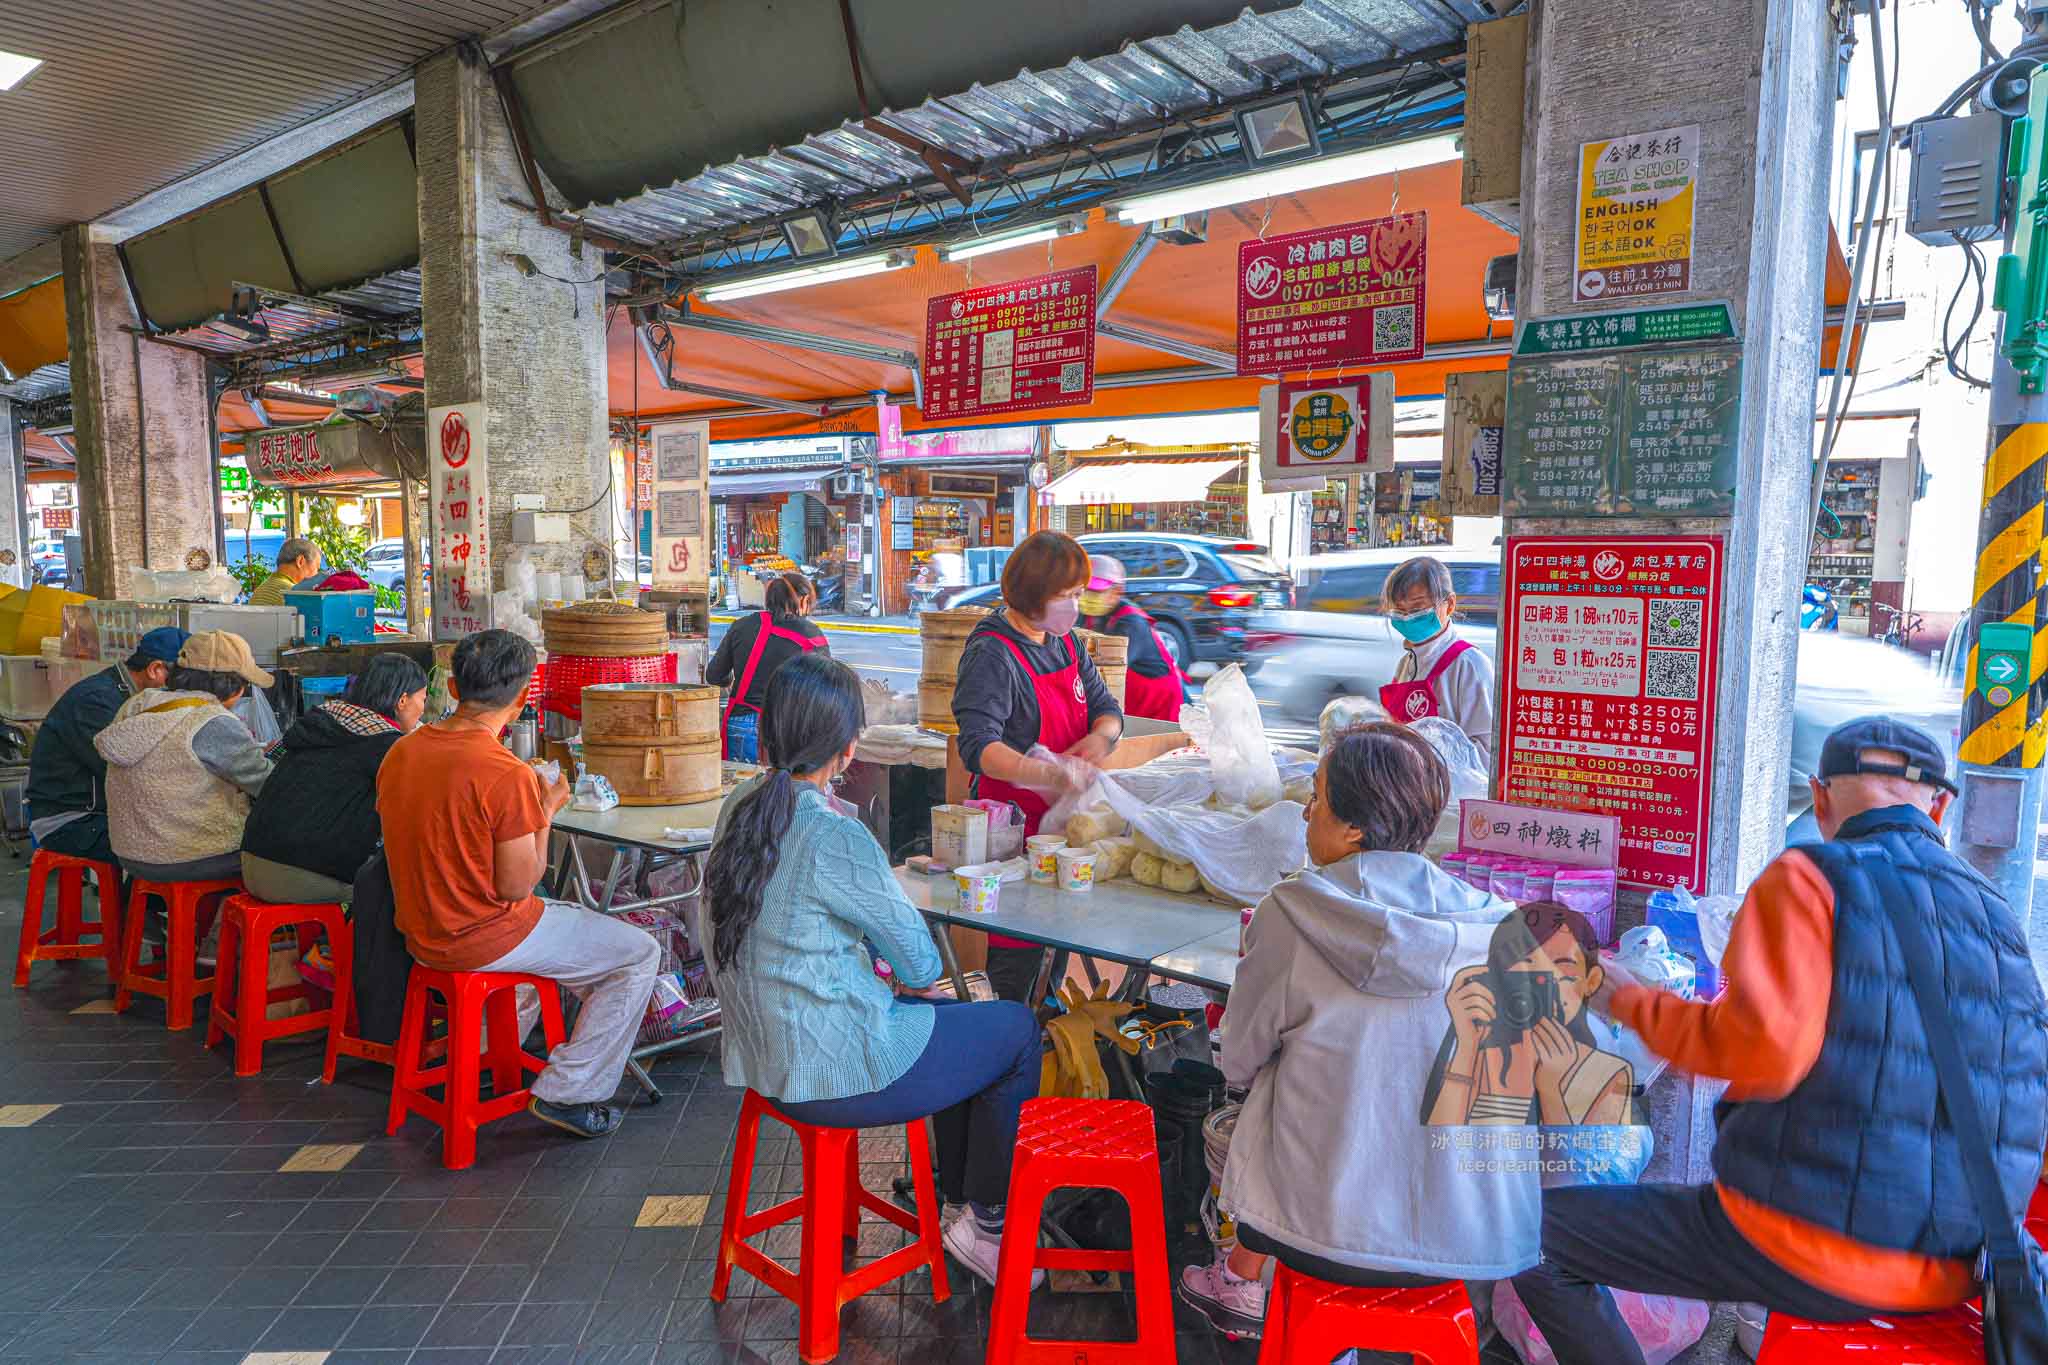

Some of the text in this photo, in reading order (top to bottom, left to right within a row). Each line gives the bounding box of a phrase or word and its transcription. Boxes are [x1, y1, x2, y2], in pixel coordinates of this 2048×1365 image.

[1592, 159, 1689, 186] TEA SHOP
[1585, 198, 1658, 218] ENGLISH
[1288, 234, 1367, 264] 冷凍肉包
[1282, 268, 1417, 302] 0970-135-007
[1607, 279, 1682, 295] WALK FOR 1 MIN
[1536, 316, 1637, 341] 永樂里公佈欄
[1307, 348, 1327, 357] Code
[1519, 555, 1587, 568] 妙口四神湯
[1524, 605, 1569, 624] 四神湯
[1523, 646, 1536, 665] 肉
[1554, 648, 1567, 666] 包
[1492, 820, 1602, 856] 四神燉料
[1655, 841, 1691, 856] Google
